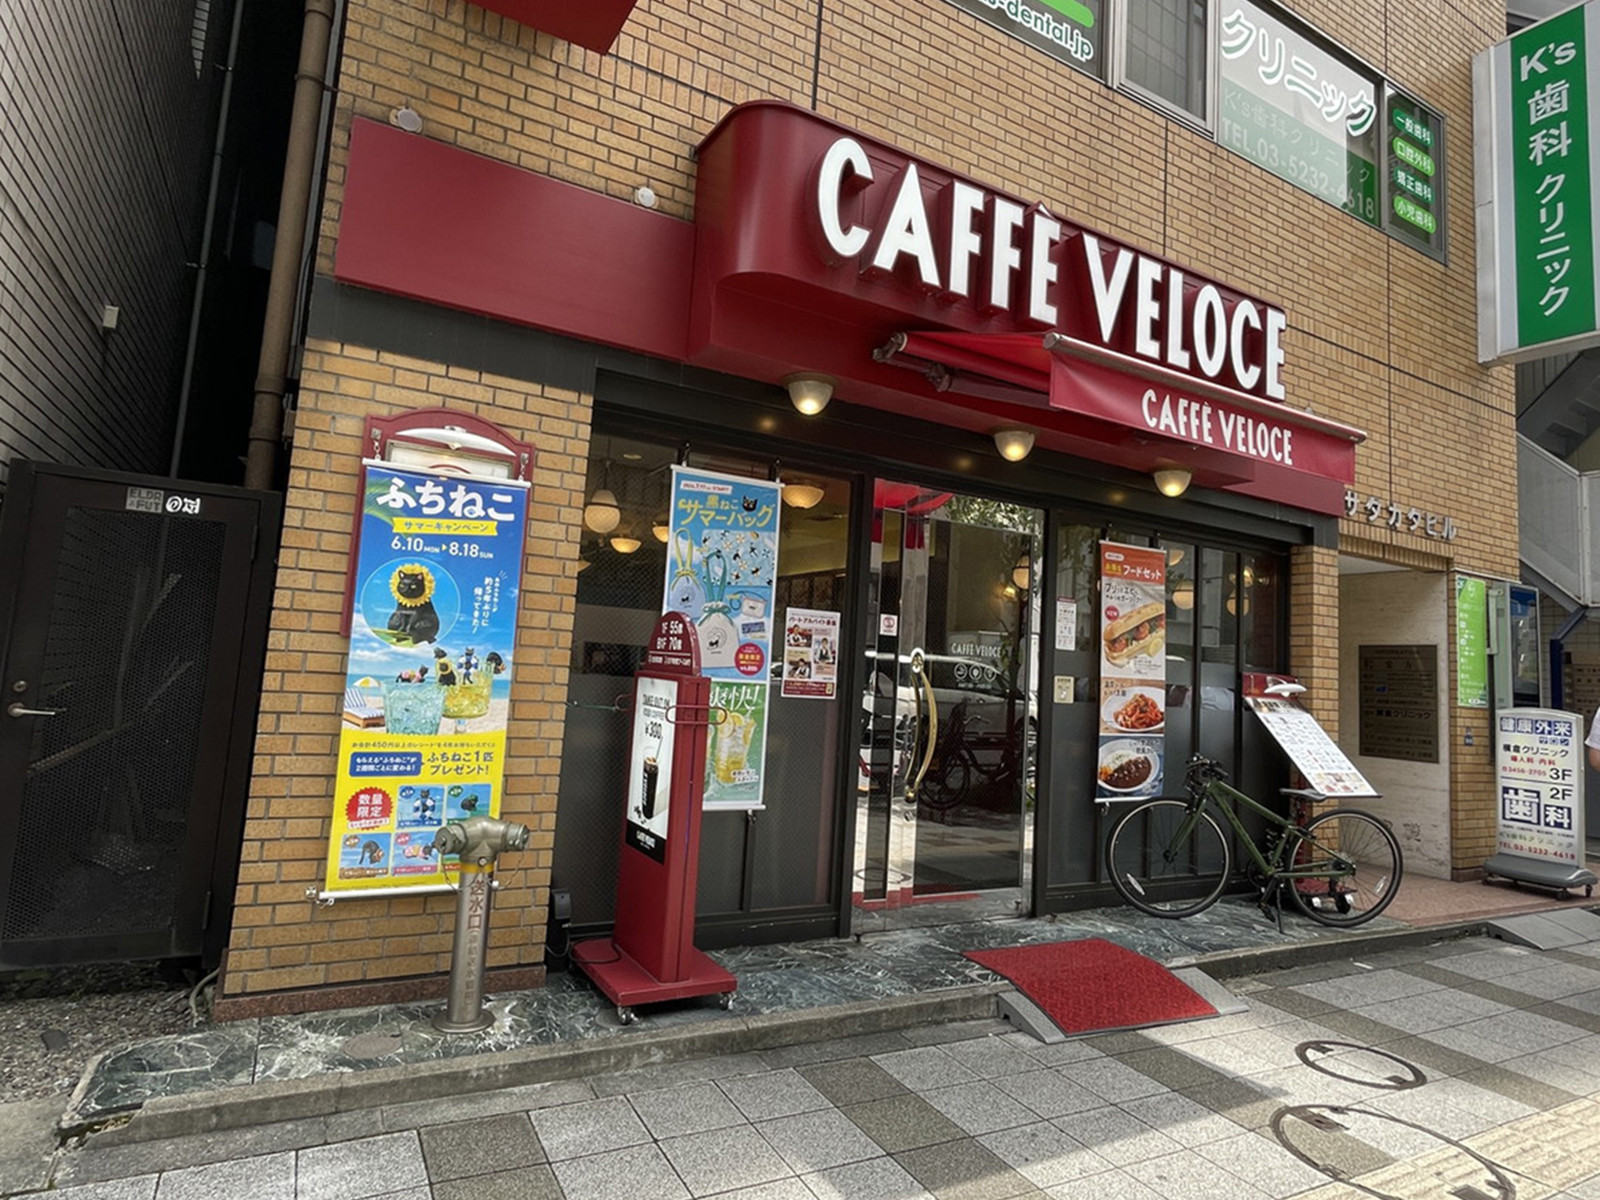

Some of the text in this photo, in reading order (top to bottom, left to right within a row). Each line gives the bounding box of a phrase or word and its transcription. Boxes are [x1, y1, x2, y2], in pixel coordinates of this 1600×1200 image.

[1222, 10, 1377, 136] クリニック
[1396, 115, 1431, 145] 一般歯科
[818, 137, 1286, 400] CAFFÈ VELOCE
[1142, 388, 1293, 465] CAFFÈ VELOCE
[376, 477, 515, 521] ふちねこ
[678, 499, 776, 528] サマーバッグ
[403, 519, 490, 533] サマーキャンペーン
[391, 536, 423, 552] 6.10
[449, 541, 479, 559] 8.18
[1122, 564, 1162, 580] フードセット
[1503, 744, 1569, 758] 横倉クリニック
[429, 763, 490, 776] プレゼント!
[1549, 768, 1573, 781] 3F
[358, 794, 383, 806] 数量
[1550, 787, 1573, 801] 2F
[356, 806, 382, 818] 限定
[1502, 788, 1571, 829] 歯科
